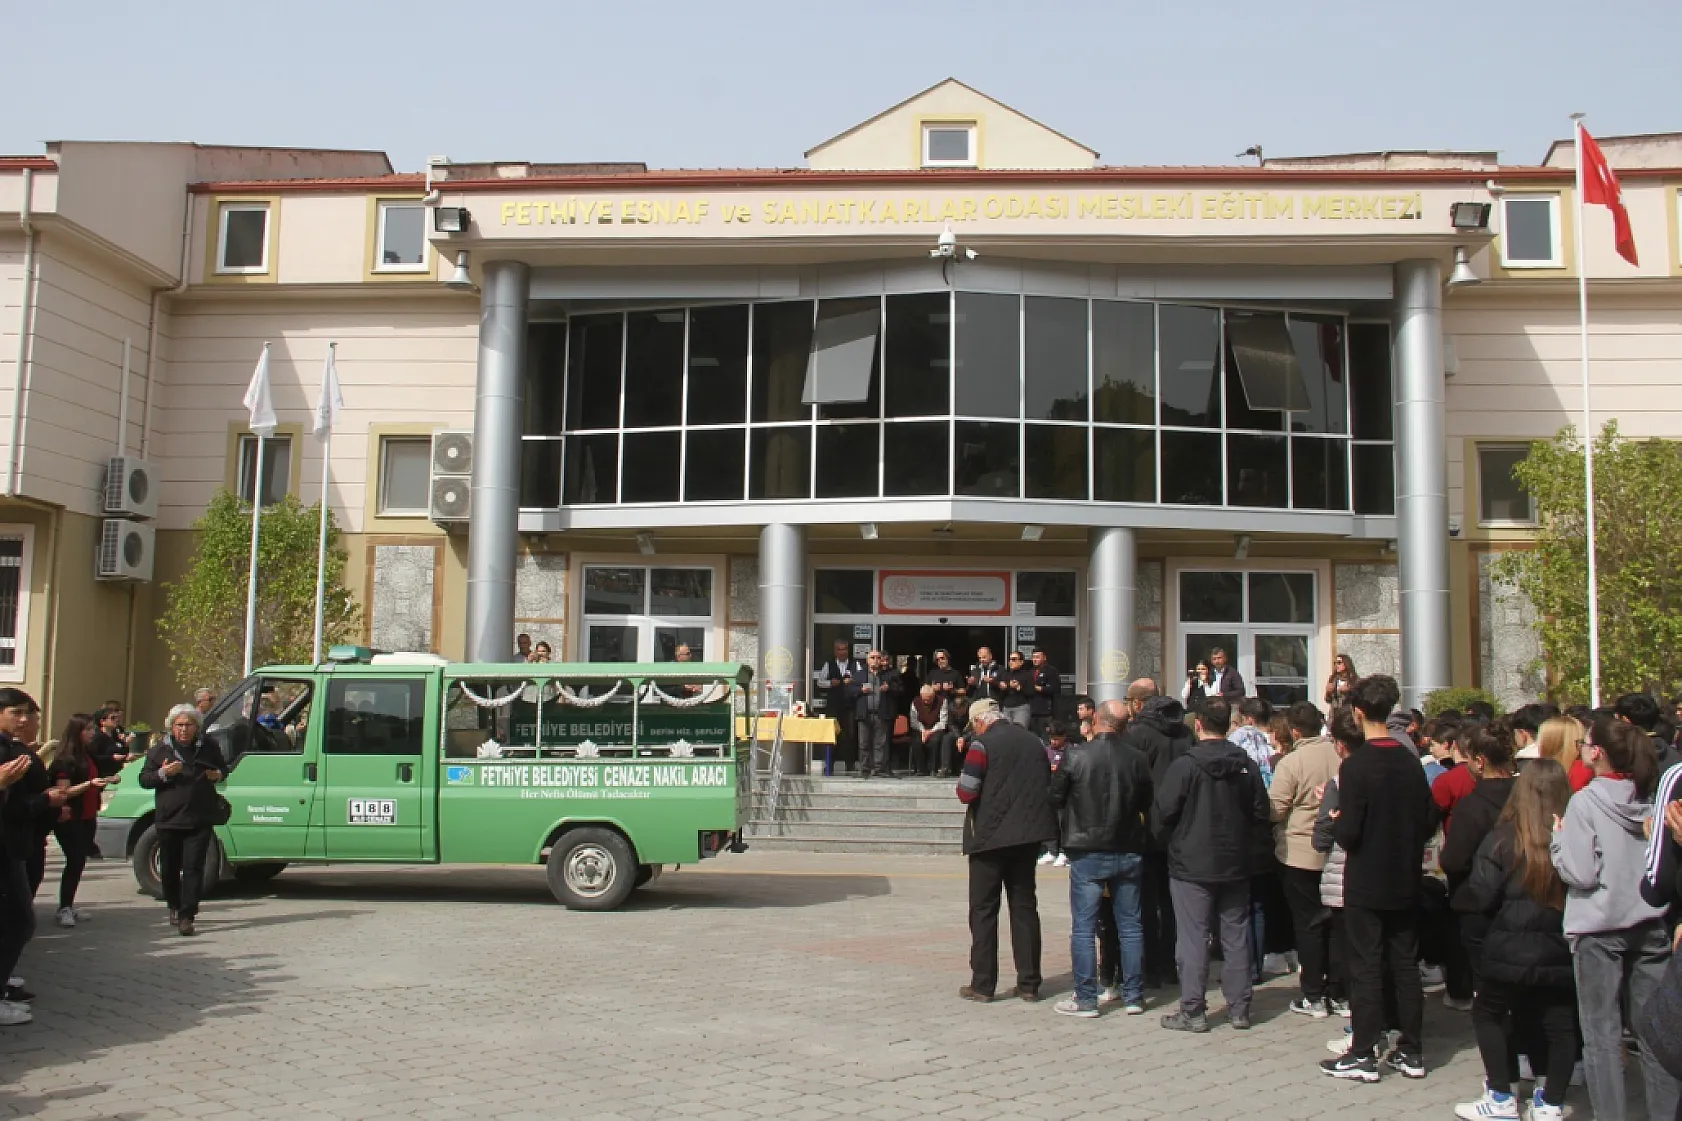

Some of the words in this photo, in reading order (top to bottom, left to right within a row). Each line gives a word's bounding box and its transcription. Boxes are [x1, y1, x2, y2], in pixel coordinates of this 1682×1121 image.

[500, 196, 612, 225] FETHİYE
[621, 200, 708, 224] ESNAF
[721, 205, 751, 223] ve
[762, 197, 977, 224] SANATKARLAR
[983, 194, 1069, 219] ODASI
[1078, 192, 1193, 219] MESLEKİ
[1201, 190, 1294, 219] EĞİTİM
[1302, 192, 1422, 219] MERKEZİ
[604, 766, 650, 786] CENAZE
[691, 766, 727, 786] ARACI
[354, 803, 391, 814] 188
